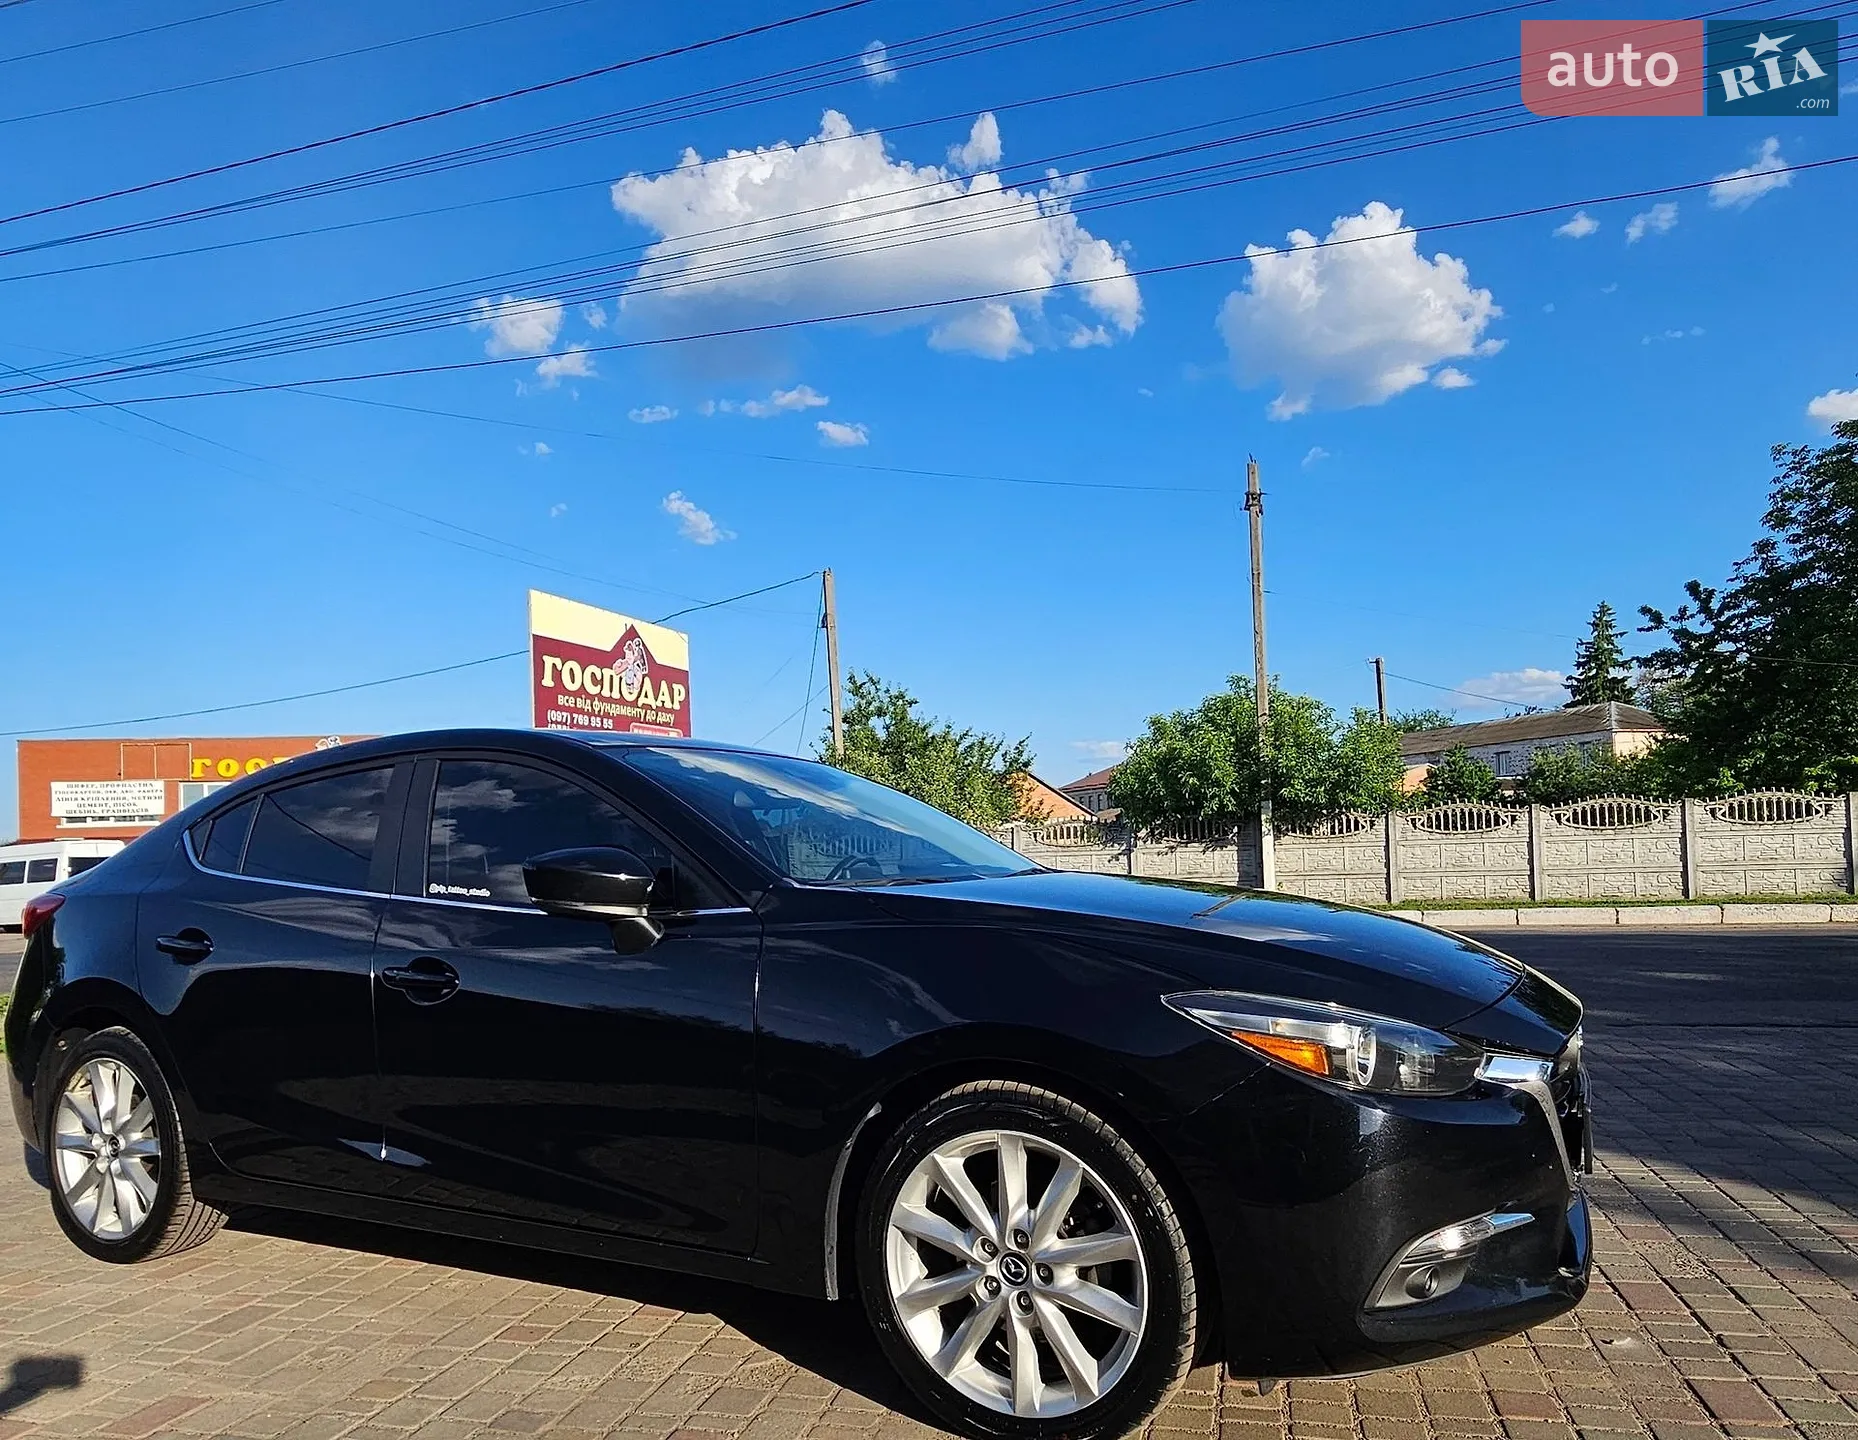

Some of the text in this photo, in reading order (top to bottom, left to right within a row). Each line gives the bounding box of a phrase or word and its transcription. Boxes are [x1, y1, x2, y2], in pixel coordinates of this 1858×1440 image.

[541, 655, 686, 710] ГОСПОДАР
[547, 709, 571, 726] (097)
[572, 713, 589, 726] 769
[590, 716, 602, 728] 95
[557, 694, 675, 727] все від фундаменту до даху
